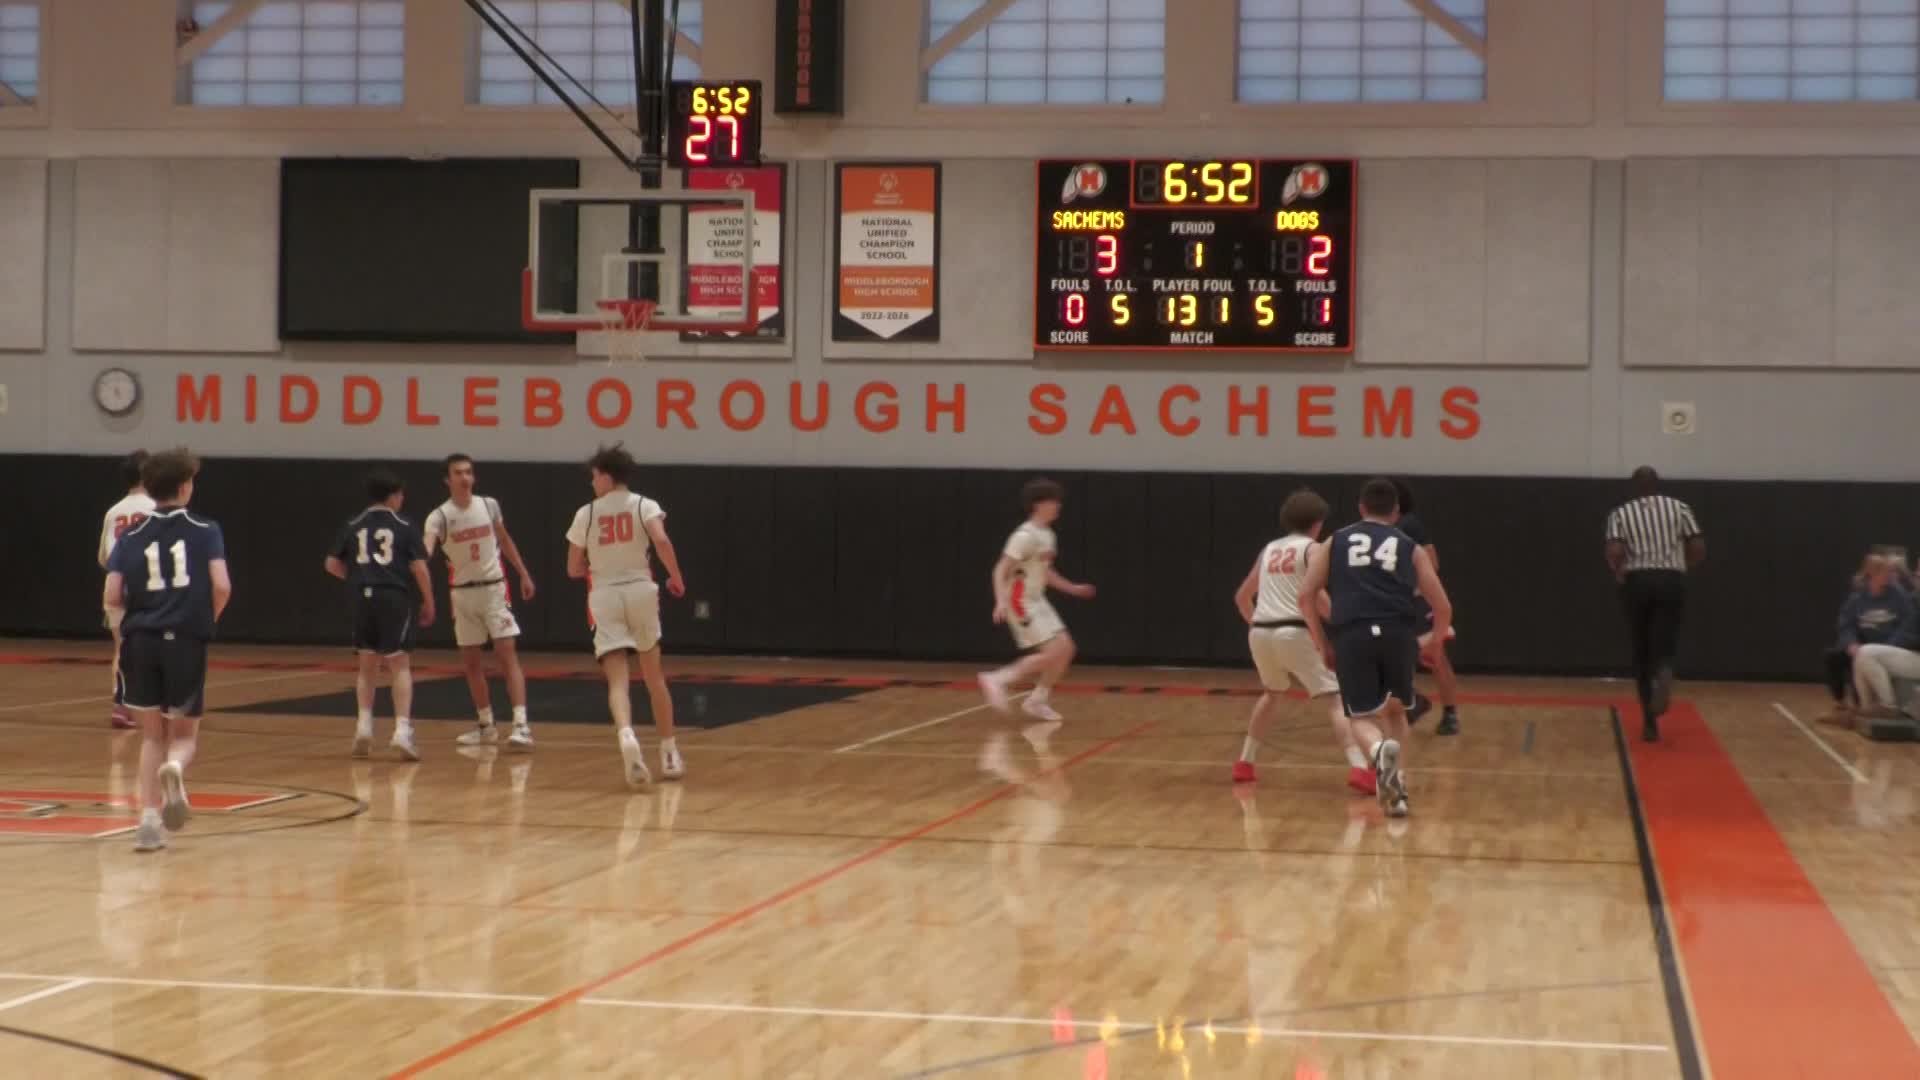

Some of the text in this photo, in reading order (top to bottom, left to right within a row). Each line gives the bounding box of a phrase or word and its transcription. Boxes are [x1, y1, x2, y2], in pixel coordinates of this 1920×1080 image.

[693, 87, 750, 114] 6:52
[686, 115, 738, 160] 27
[1164, 163, 1252, 203] 6:52
[709, 218, 759, 226] NATIOL
[862, 217, 913, 226] NATIONAL
[1053, 211, 1125, 230] SACHEMS
[1170, 222, 1216, 234] PERIOD
[1277, 211, 1320, 231] DOGS
[706, 239, 761, 248] CHAMPN
[859, 239, 915, 249] CHAMPION
[867, 229, 908, 238] UNIFIED
[866, 251, 908, 260] SCHOOL
[1096, 235, 1117, 274] 3
[1195, 242, 1203, 268] 1
[1308, 235, 1332, 275] 2
[1051, 279, 1090, 291] FOULS
[1104, 279, 1138, 291] T.O.L.
[1153, 279, 1235, 292] PLAYER FOUL
[1248, 279, 1282, 291] T.O.L.
[1296, 280, 1336, 293] FOULS
[1066, 294, 1084, 324] 0
[1111, 294, 1130, 325] 5
[1168, 295, 1197, 325] 13
[1221, 298, 1229, 323] 1
[1255, 294, 1275, 327] 5
[1323, 298, 1331, 323] 1
[1050, 331, 1089, 344] SCORE
[1170, 331, 1214, 344] MATCH
[1295, 333, 1336, 346] SCORE
[175, 373, 1481, 440] MIDDLEBOROUGH SACHEMS
[597, 512, 634, 545] 30
[355, 528, 394, 565] 13
[1348, 533, 1400, 572] 24
[144, 539, 190, 591] 11
[1268, 548, 1297, 574] 22
